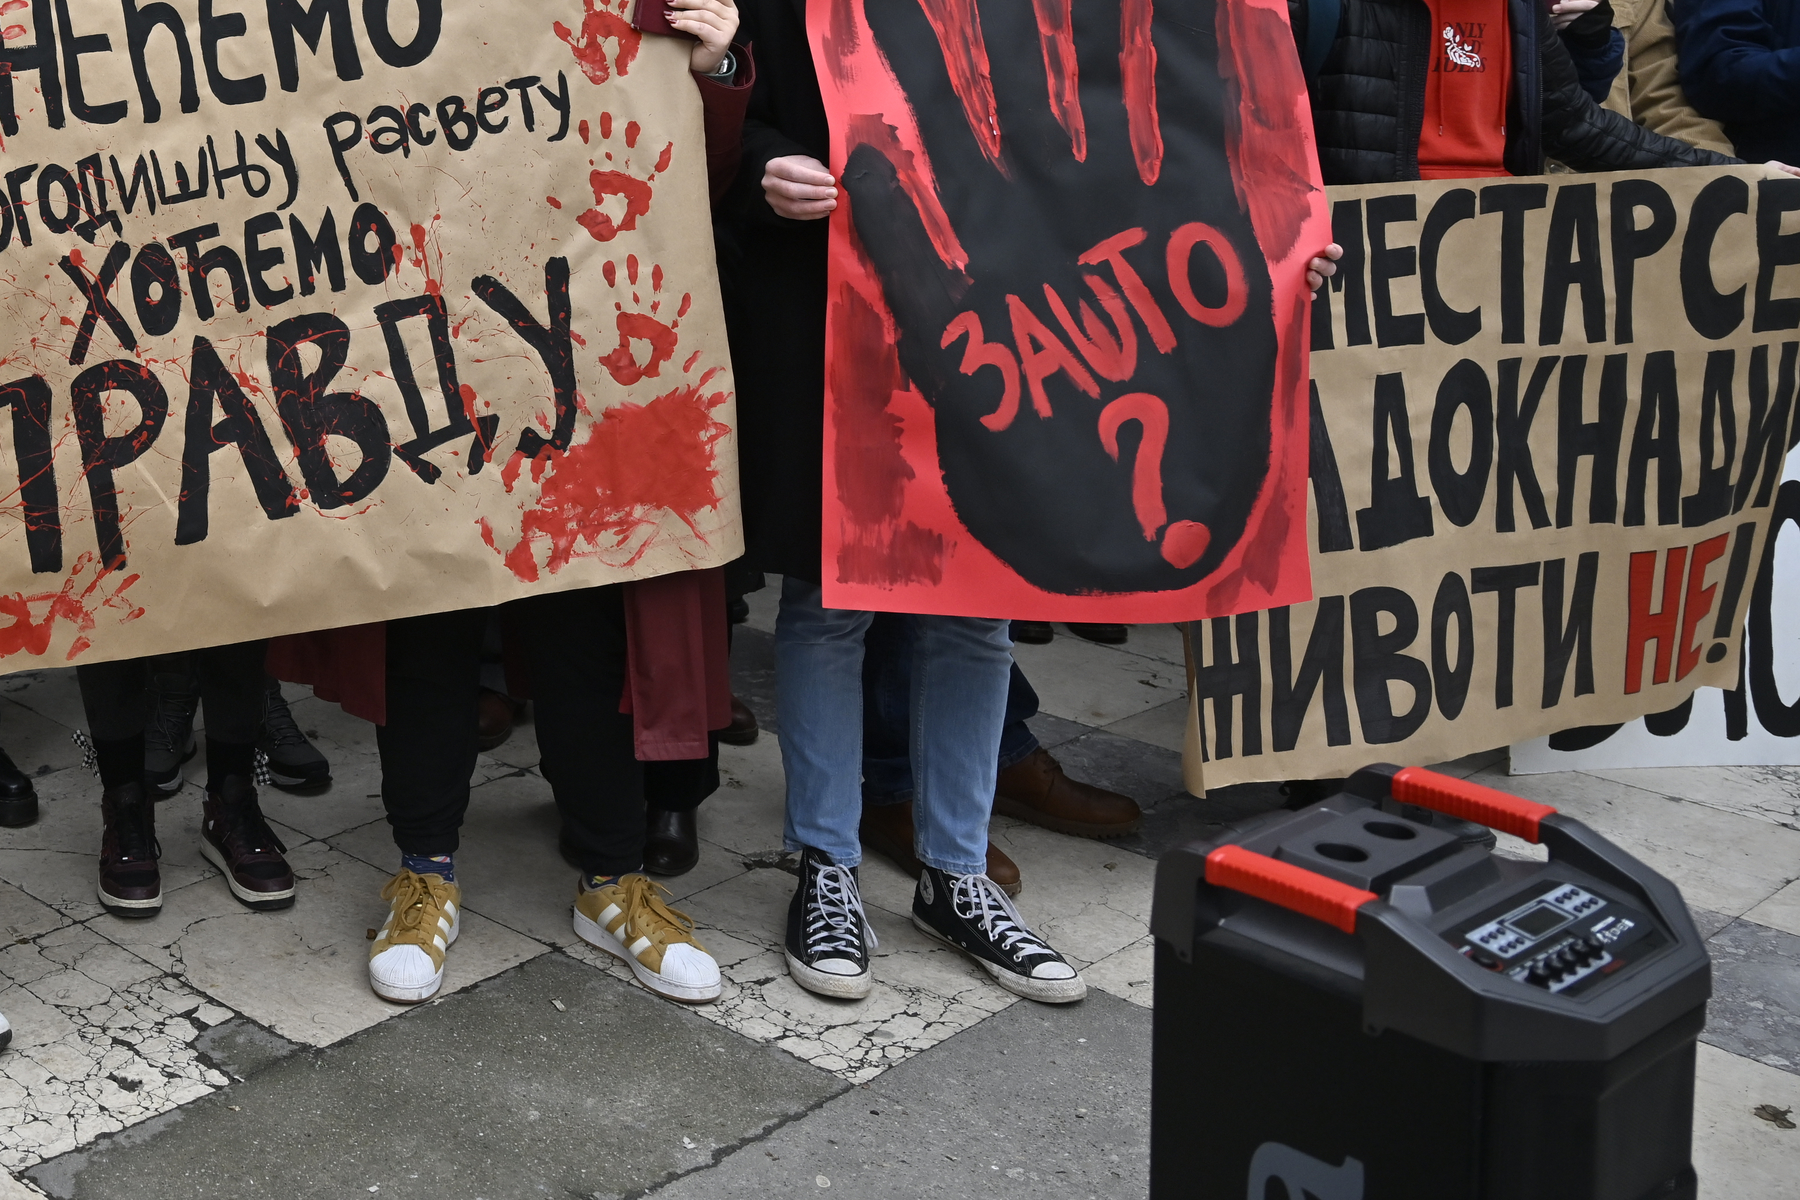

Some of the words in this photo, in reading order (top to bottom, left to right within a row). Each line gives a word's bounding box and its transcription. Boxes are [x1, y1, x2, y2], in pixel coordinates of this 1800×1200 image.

[1432, 56, 1488, 73] IDES
[58, 202, 399, 366] ХОЋЕМО
[940, 221, 1249, 432] ЗАШТО
[1202, 552, 1600, 762] ЖИВОТИ
